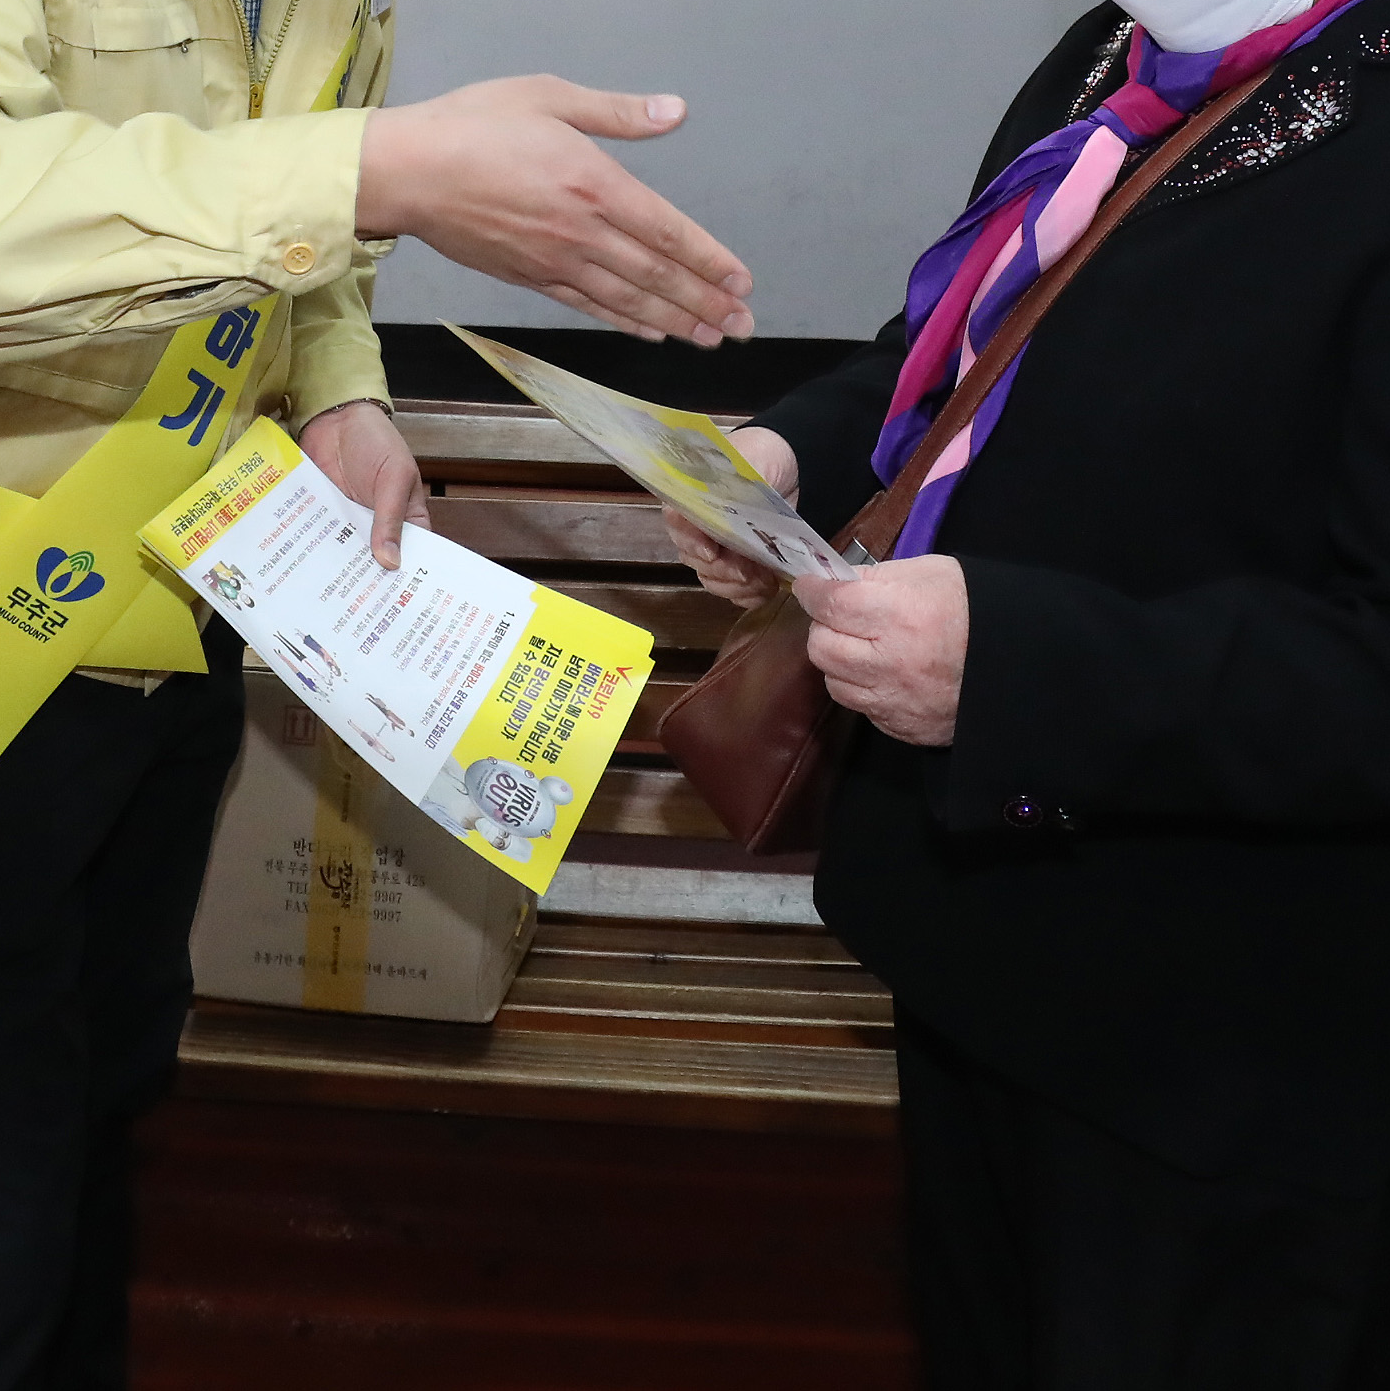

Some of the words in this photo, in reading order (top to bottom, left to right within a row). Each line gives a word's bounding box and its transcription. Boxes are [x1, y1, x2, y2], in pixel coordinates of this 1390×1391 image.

[238, 451, 265, 478] 전라북도
[216, 475, 239, 496] 무주군
[231, 488, 255, 512] 감염은
[214, 504, 238, 528] 고통의
[7, 586, 69, 636] 무주군
[18, 621, 50, 644] COUNTY
[520, 647, 537, 664] 수
[539, 643, 562, 669] 지금
[562, 652, 585, 680] 남의
[495, 659, 531, 708] 있습니다.
[522, 664, 550, 701] 당신의
[563, 661, 603, 720] 바이러스에
[585, 670, 619, 721] 코로나19
[539, 677, 572, 723] 이야기가
[499, 697, 532, 742] 이야기가
[552, 716, 575, 743] 의한
[515, 718, 550, 769] 아닙니다.
[541, 739, 562, 765] 사망
[500, 779, 538, 831] VIRUS
